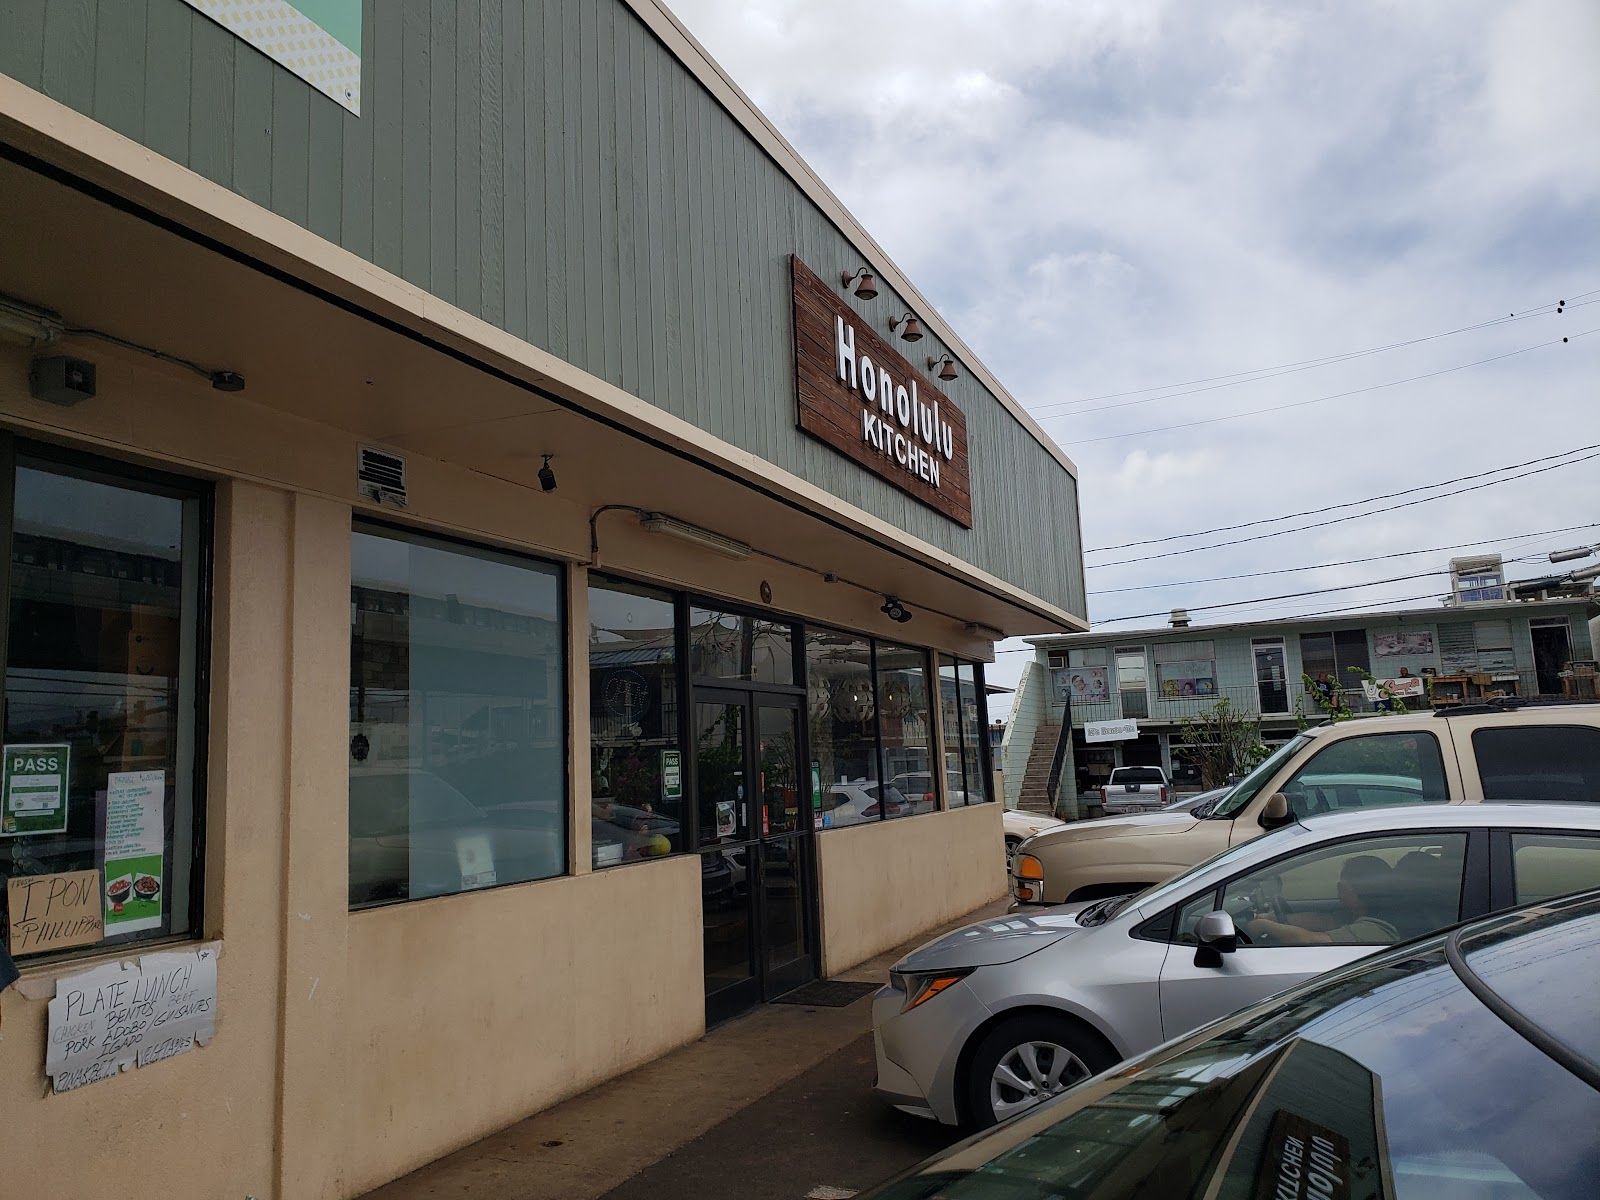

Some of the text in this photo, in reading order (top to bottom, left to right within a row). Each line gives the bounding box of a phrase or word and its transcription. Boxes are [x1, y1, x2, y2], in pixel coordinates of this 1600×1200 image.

[835, 314, 953, 461] Honolulu
[863, 408, 940, 488] KITCHEN
[13, 757, 59, 772] PASS
[665, 757, 679, 766] PASS
[66, 963, 193, 1021] PLATE LUNCH
[104, 1000, 157, 1030] BENTOS
[64, 1035, 97, 1061] PORK
